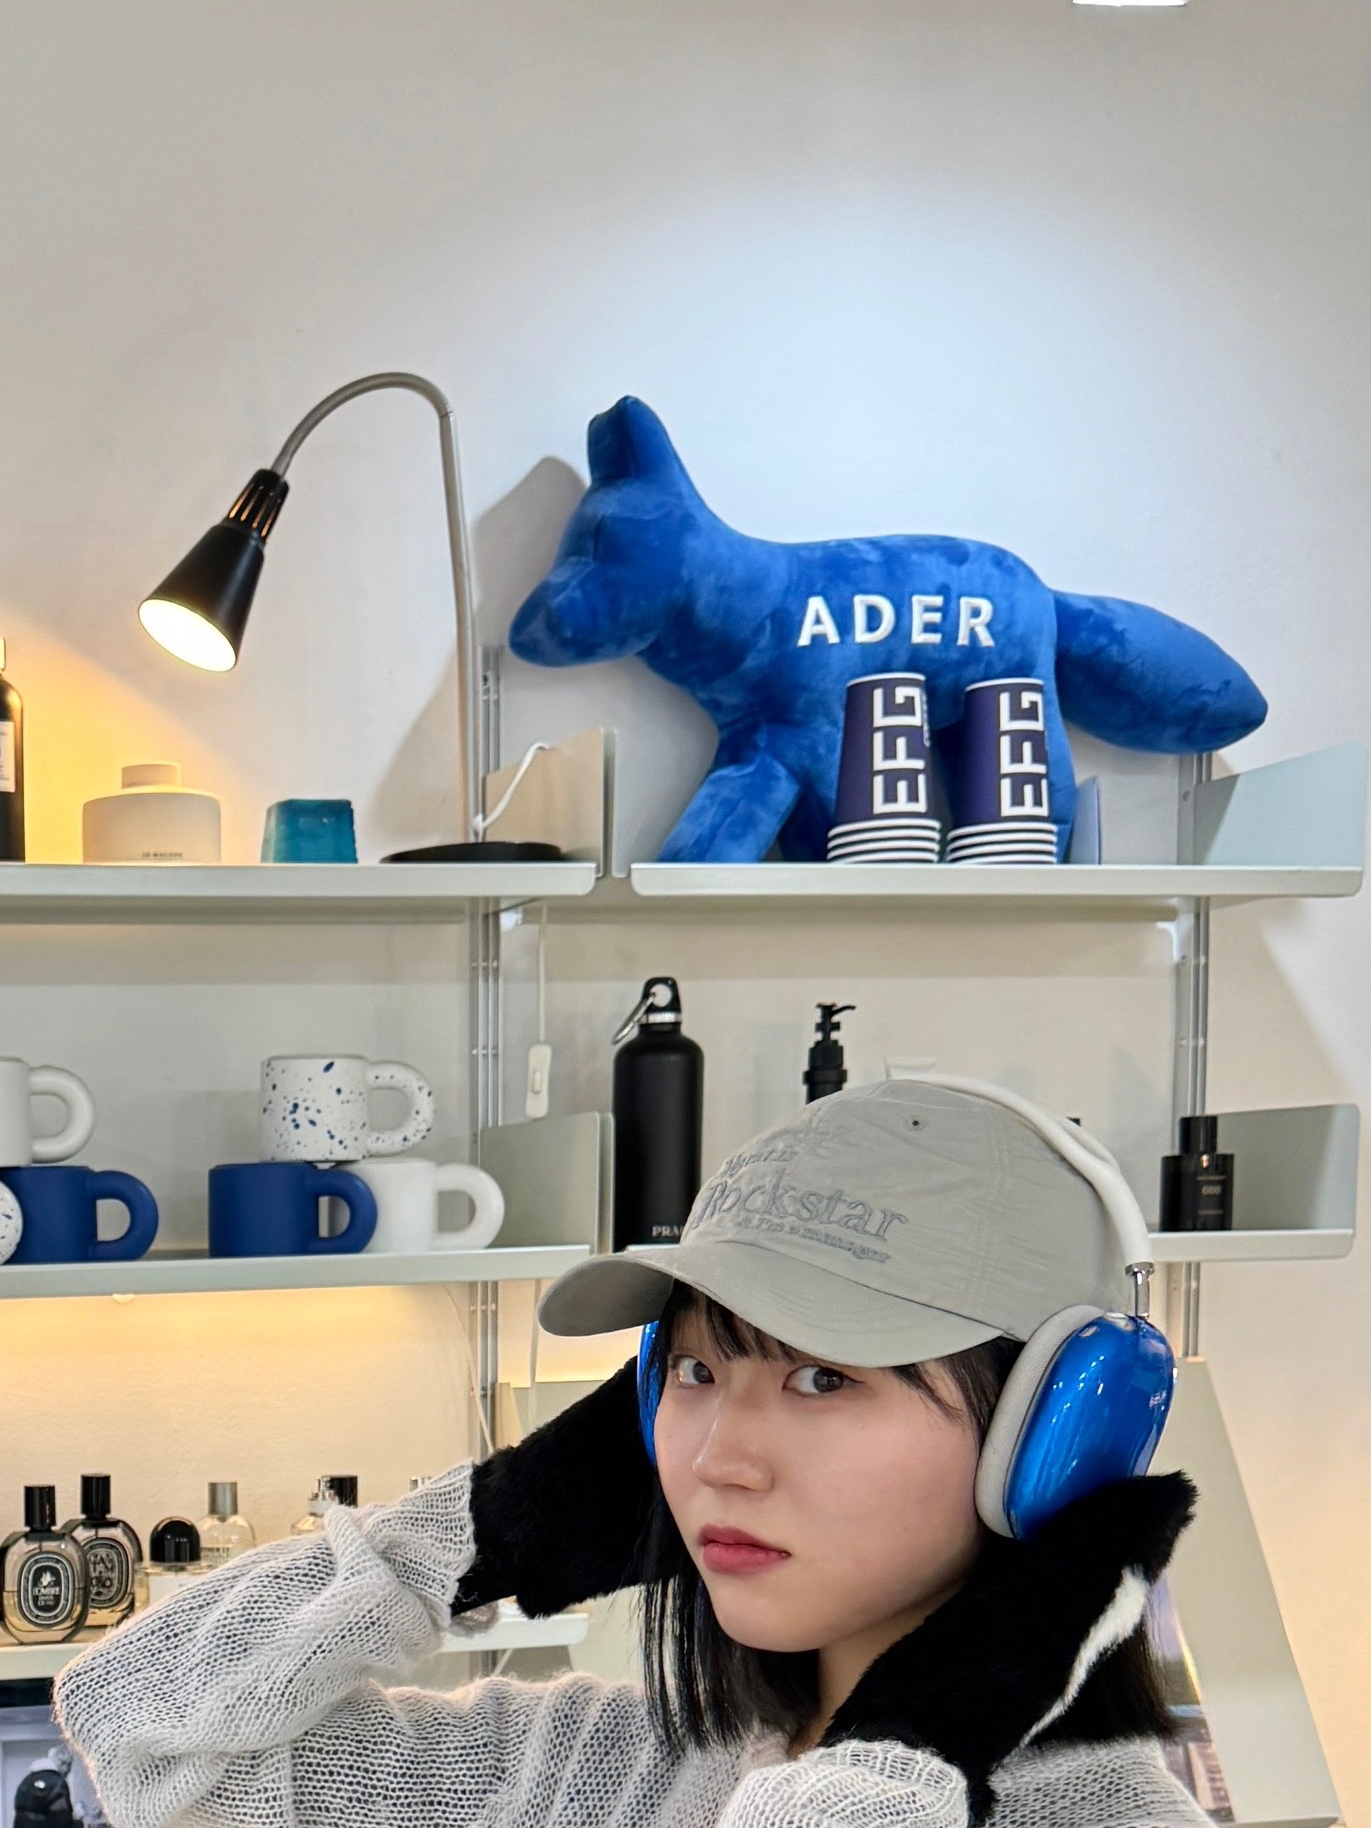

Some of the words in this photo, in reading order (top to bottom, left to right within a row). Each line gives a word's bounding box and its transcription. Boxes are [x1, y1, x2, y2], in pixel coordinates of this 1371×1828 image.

[797, 594, 995, 647] ADER
[873, 686, 928, 814] EFG
[999, 691, 1049, 817] EFG
